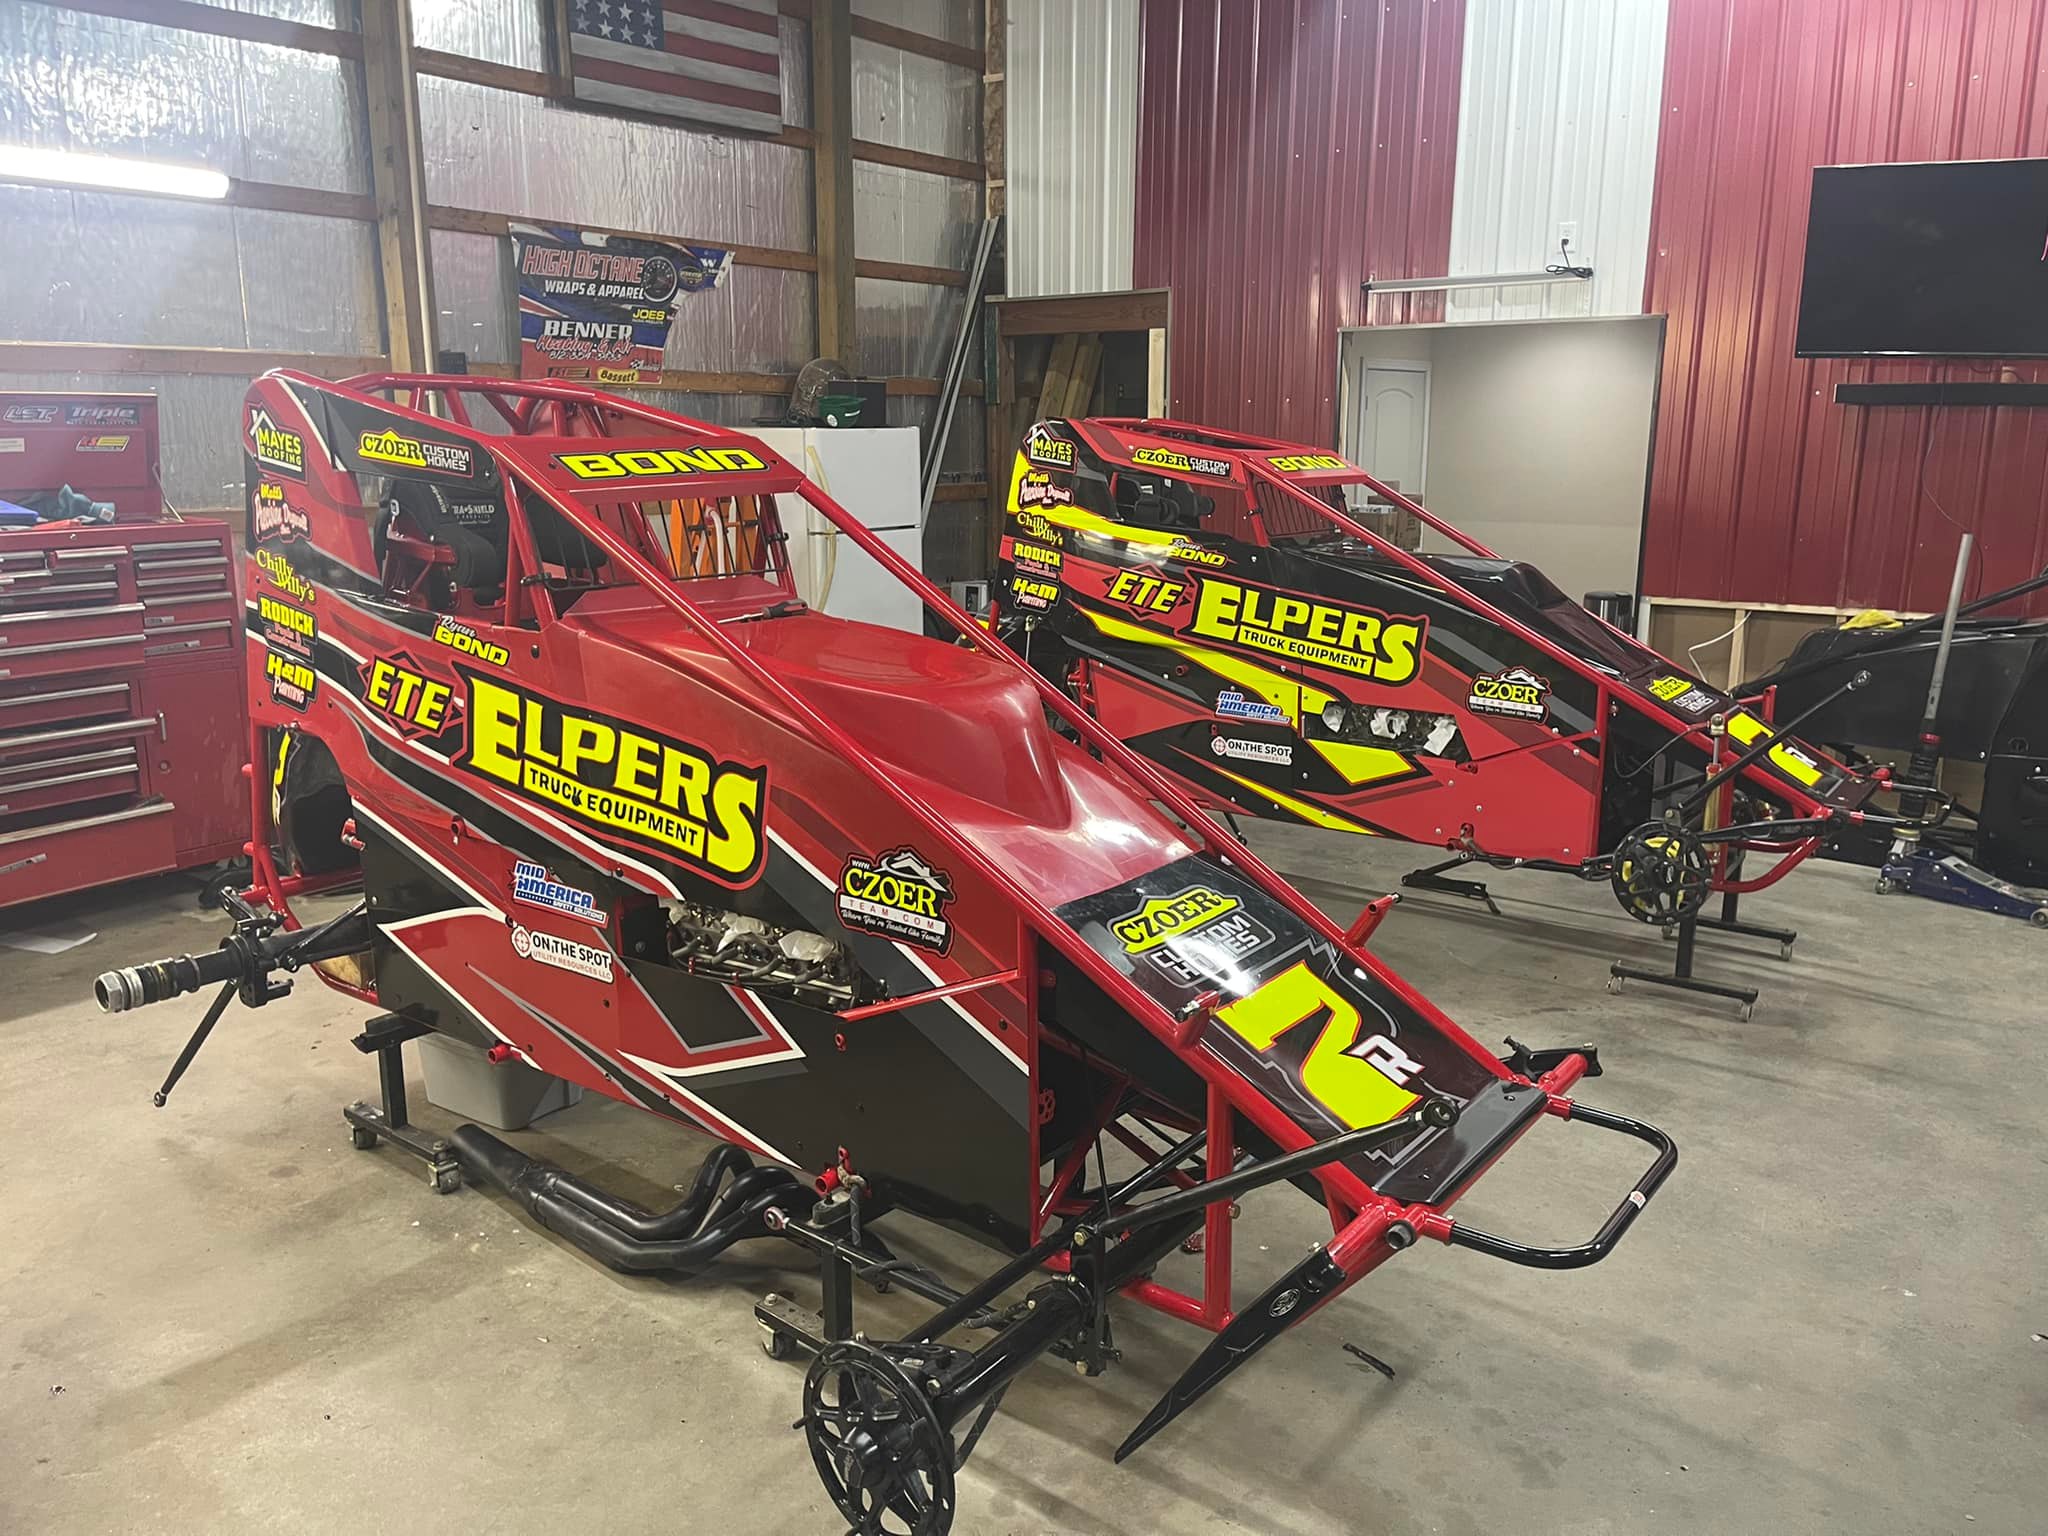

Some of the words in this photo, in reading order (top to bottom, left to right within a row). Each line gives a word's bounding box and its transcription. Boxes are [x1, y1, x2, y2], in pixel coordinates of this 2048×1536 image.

[522, 245, 573, 278] HIGH
[573, 250, 645, 283] OCTANE
[545, 280, 586, 295] WRAPS
[586, 284, 596, 296] &
[597, 284, 645, 300] APPAREL
[633, 308, 665, 320] JOES
[544, 320, 632, 339] BENNER
[612, 336, 633, 354] Air
[600, 369, 636, 382] Bassett
[258, 427, 301, 454] MAYES
[363, 436, 421, 460] CZOER
[1034, 438, 1072, 455] MAYES
[260, 446, 301, 465] ROOFING
[423, 444, 470, 461] CUSTOM
[427, 455, 466, 472] HOMES
[559, 448, 765, 478] BOND
[1137, 450, 1187, 466] CZOER
[1190, 457, 1229, 469] CUSTOM
[1268, 456, 1347, 471] BOND
[1192, 464, 1226, 475] HOMES
[1017, 512, 1050, 532] Chilly
[1015, 543, 1060, 566] RODICH
[1169, 547, 1225, 565] BOND
[1108, 572, 1186, 612] ETE
[260, 597, 314, 637] RODICH
[441, 615, 476, 637] Ryan
[1192, 578, 1418, 682] ELPERS
[435, 625, 508, 666] BOND
[1244, 630, 1285, 650] TRUCK
[1288, 642, 1367, 669] EQUIPMENT
[367, 657, 453, 730] ETE
[1474, 680, 1539, 704] CZOER
[1220, 700, 1280, 715] AMERICA
[1228, 741, 1242, 750] ON
[1243, 743, 1263, 753] THE
[1265, 746, 1290, 756] SPOT
[469, 678, 760, 873] ELPERS
[530, 768, 582, 805] TRUCK
[588, 793, 698, 846] EQUIPMENT
[517, 863, 545, 878] MID
[517, 877, 593, 908] AMERICA
[845, 868, 938, 917] CZOER
[1117, 890, 1222, 943] CZOER
[533, 934, 550, 950] ON
[553, 940, 577, 958] THE
[579, 947, 609, 968] SPOT
[533, 951, 558, 963] UTILITY
[558, 957, 598, 976] RESOURCES
[1213, 961, 1423, 1130] 7
[1348, 1034, 1424, 1086] R
